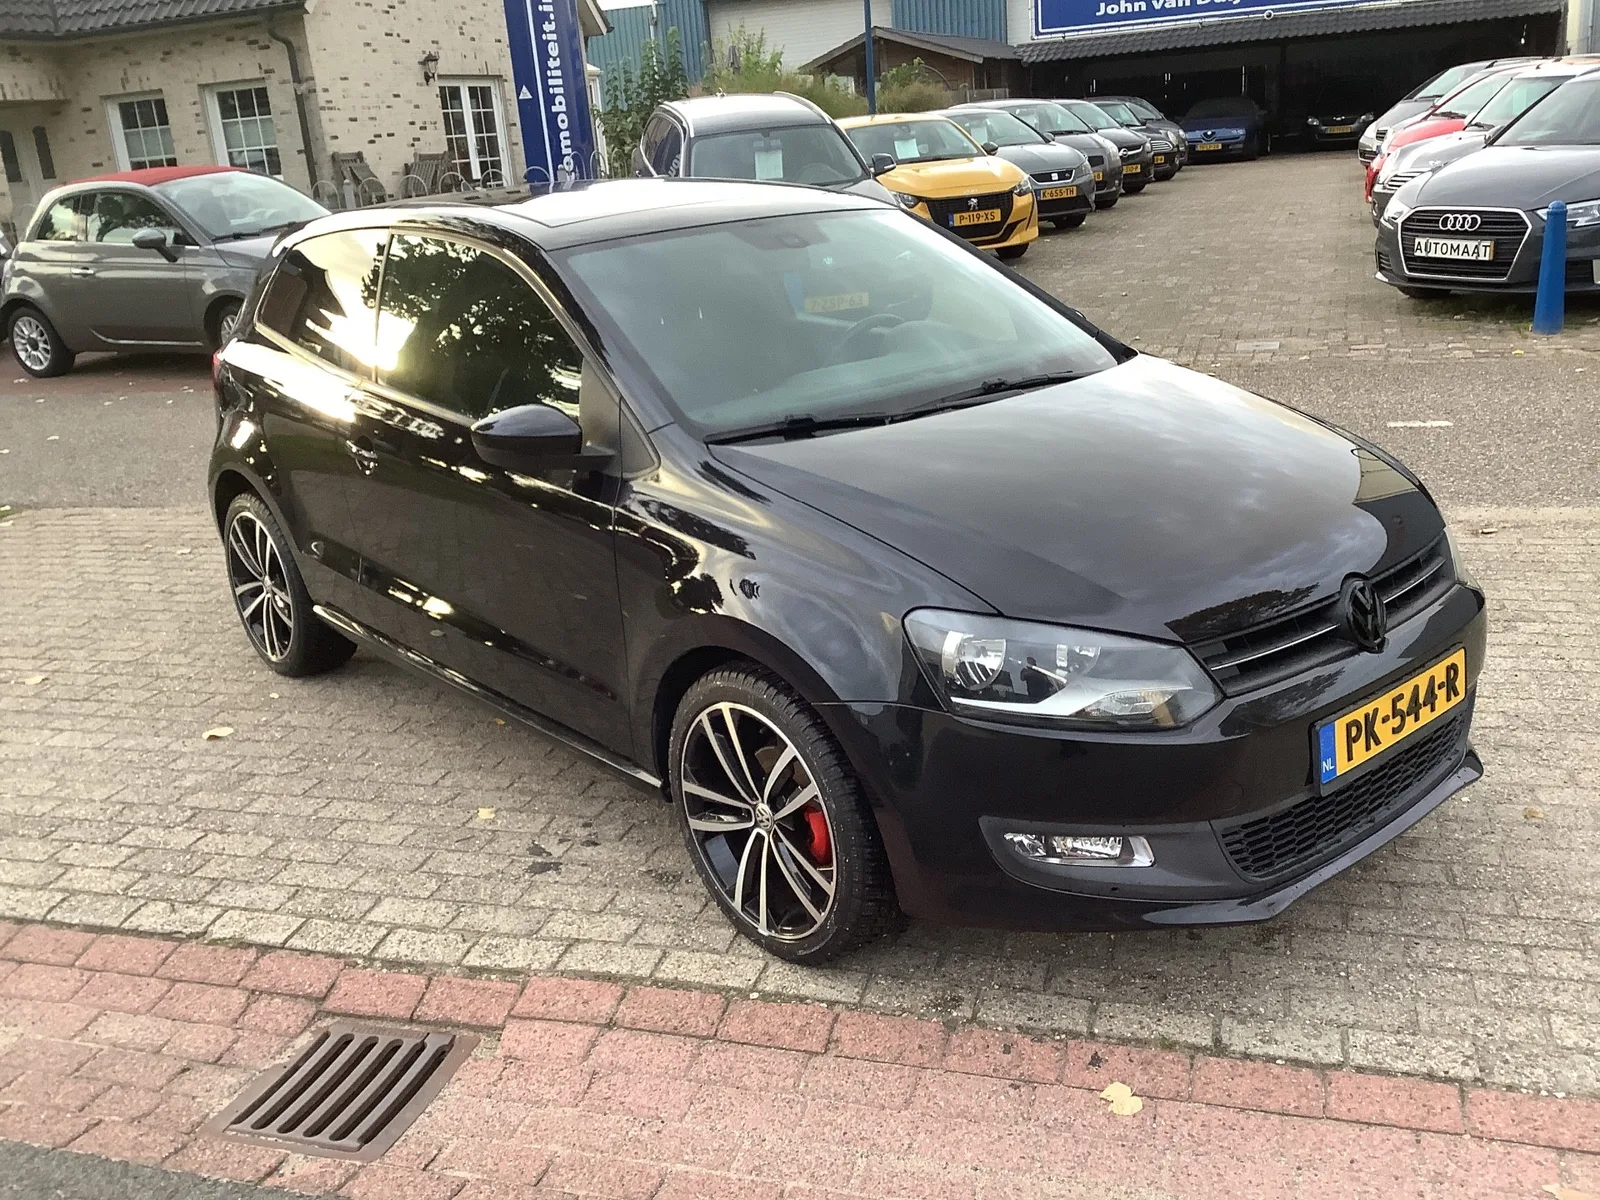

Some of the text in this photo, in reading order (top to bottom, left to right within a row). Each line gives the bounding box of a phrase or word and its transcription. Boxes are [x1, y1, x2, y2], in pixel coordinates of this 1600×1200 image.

[1096, 0, 1147, 16] John
[1043, 187, 1074, 199] K-655-TH
[958, 211, 996, 225] P-119-XS
[1414, 241, 1491, 258] AUTOMAAT
[1346, 662, 1460, 762] PK-544-R
[1322, 757, 1335, 773] NL
